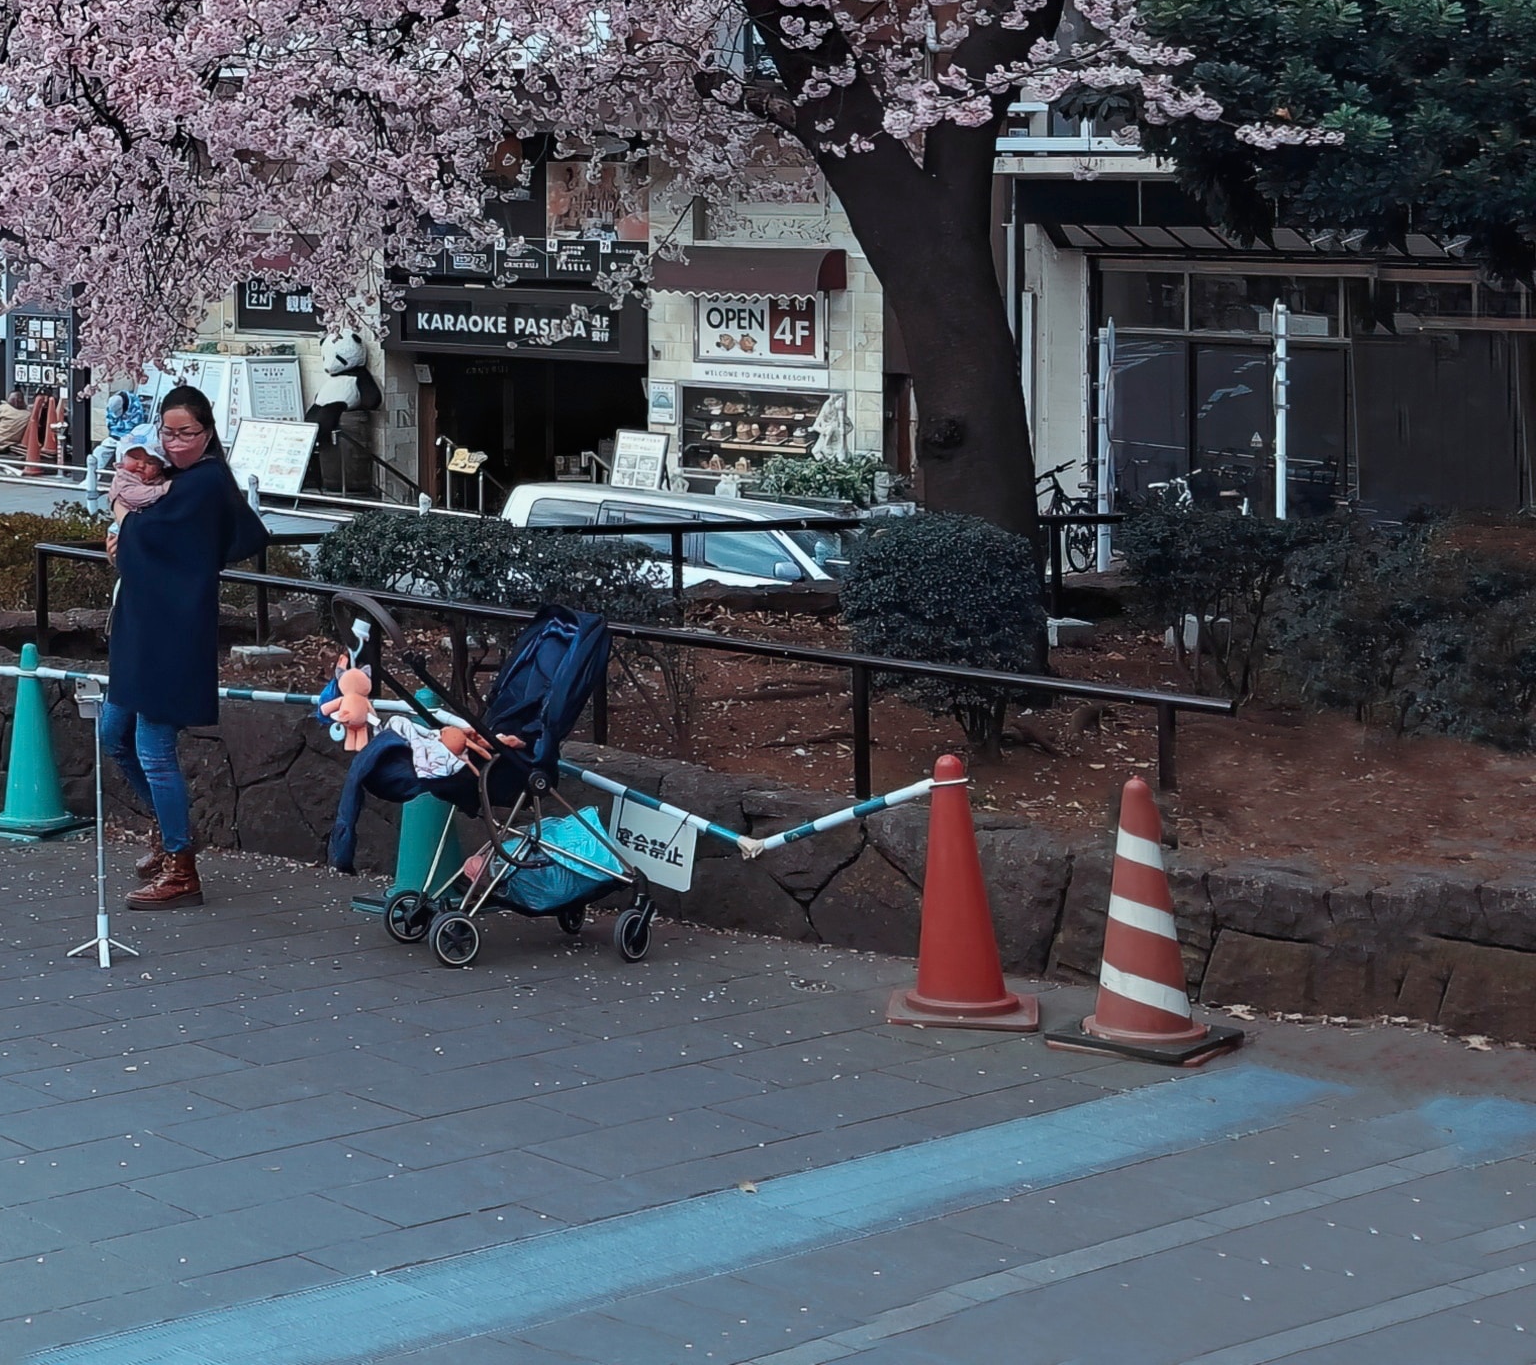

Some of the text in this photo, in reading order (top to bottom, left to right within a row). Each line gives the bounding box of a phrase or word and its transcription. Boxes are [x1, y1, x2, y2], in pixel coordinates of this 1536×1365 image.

[417, 311, 587, 338] KARAOKE PASA
[591, 314, 610, 329] 4F
[706, 307, 765, 332] OPEN
[773, 316, 810, 347] 4F
[616, 827, 684, 868] 宴会禁止
